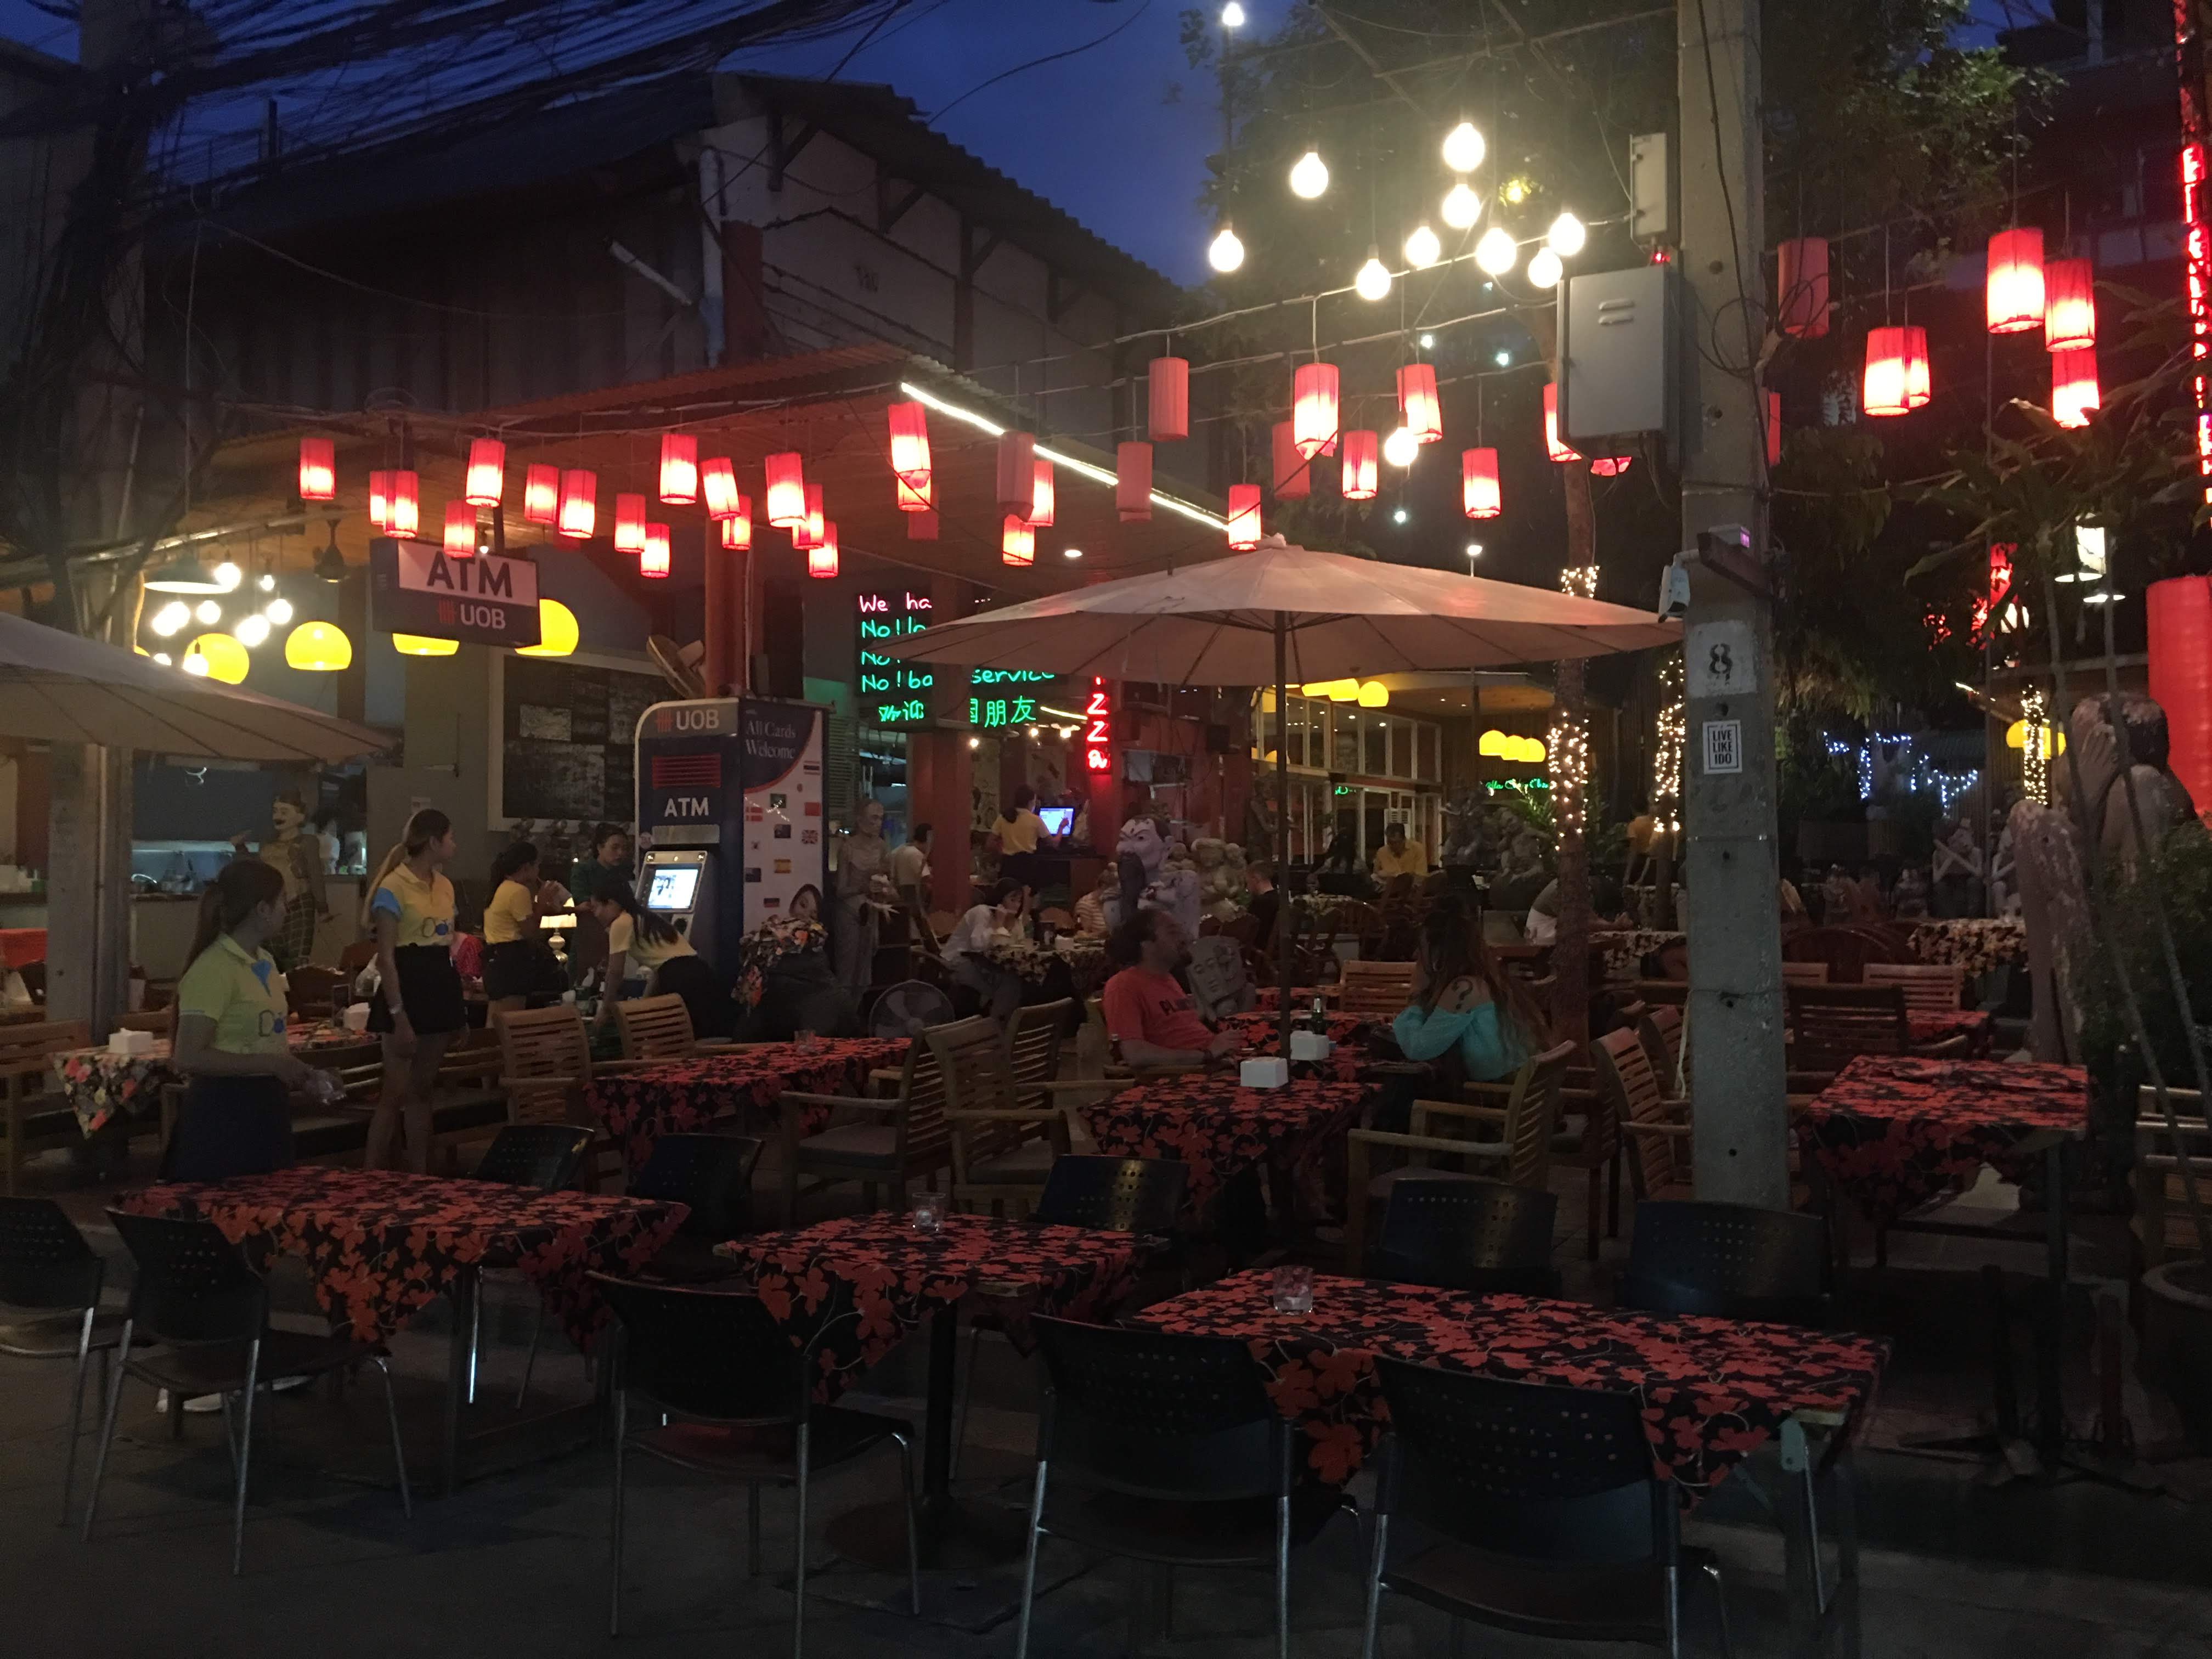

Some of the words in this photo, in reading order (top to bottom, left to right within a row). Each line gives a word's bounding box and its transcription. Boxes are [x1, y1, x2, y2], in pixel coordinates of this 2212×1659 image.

[427, 551, 512, 599] ATM
[859, 594, 888, 613] We
[460, 603, 506, 630] UOB
[1709, 644, 1733, 674] 8
[676, 709, 720, 731] UOB
[746, 720, 763, 736] All
[764, 721, 797, 738] Cards
[1713, 730, 1733, 741] LIVE
[746, 739, 795, 759] Welcome
[1713, 742, 1733, 753] LIKE
[1715, 754, 1731, 764] IDO
[664, 797, 709, 817] ATM
